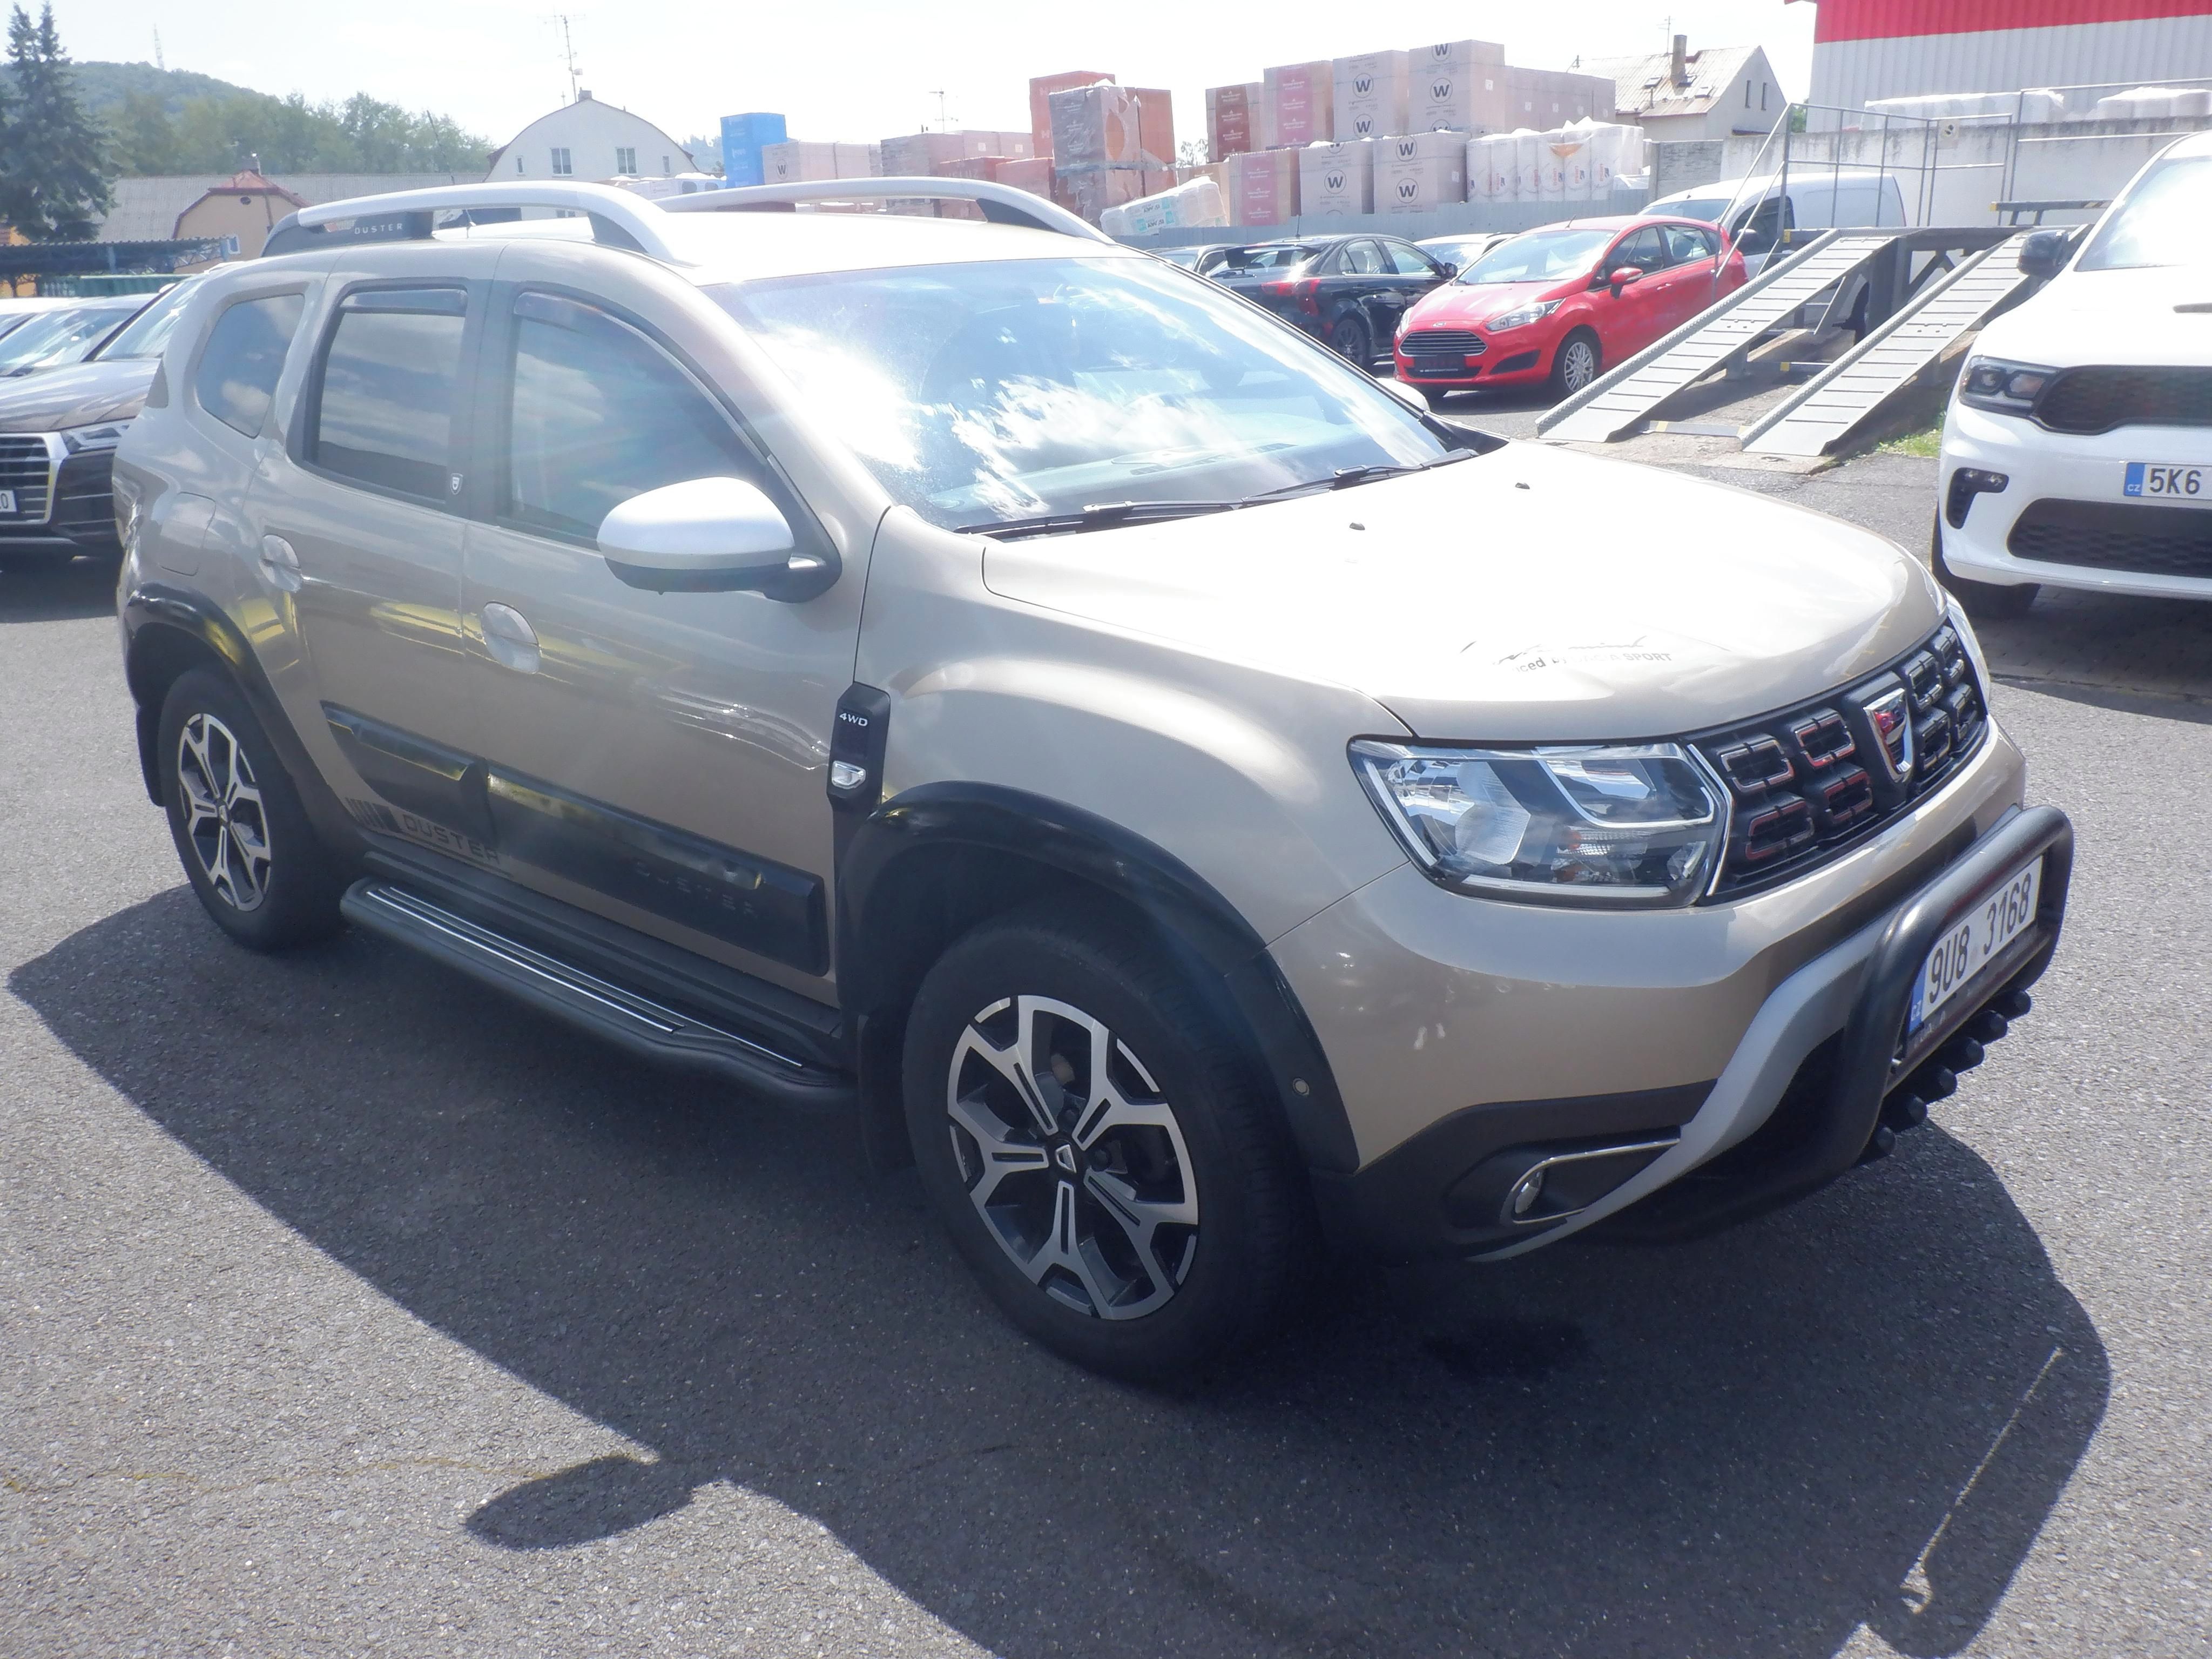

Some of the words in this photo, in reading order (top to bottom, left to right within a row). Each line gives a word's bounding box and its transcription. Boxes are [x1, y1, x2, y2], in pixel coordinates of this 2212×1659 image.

[1355, 79, 1371, 93] W
[1433, 84, 1450, 97] W
[1356, 120, 1371, 133] W
[1399, 142, 1414, 156] W
[778, 164, 786, 175] W
[1327, 176, 1344, 188] W
[1399, 185, 1416, 198] W
[354, 223, 403, 235] DUSTER
[2127, 483, 2141, 493] CZ
[2149, 468, 2202, 495] 5K6
[1622, 652, 1674, 662] SPORT
[839, 712, 868, 727] 4WD
[401, 813, 501, 865] DUSTER
[1928, 924, 1971, 1004] 9U8
[1982, 871, 2032, 956] 3168
